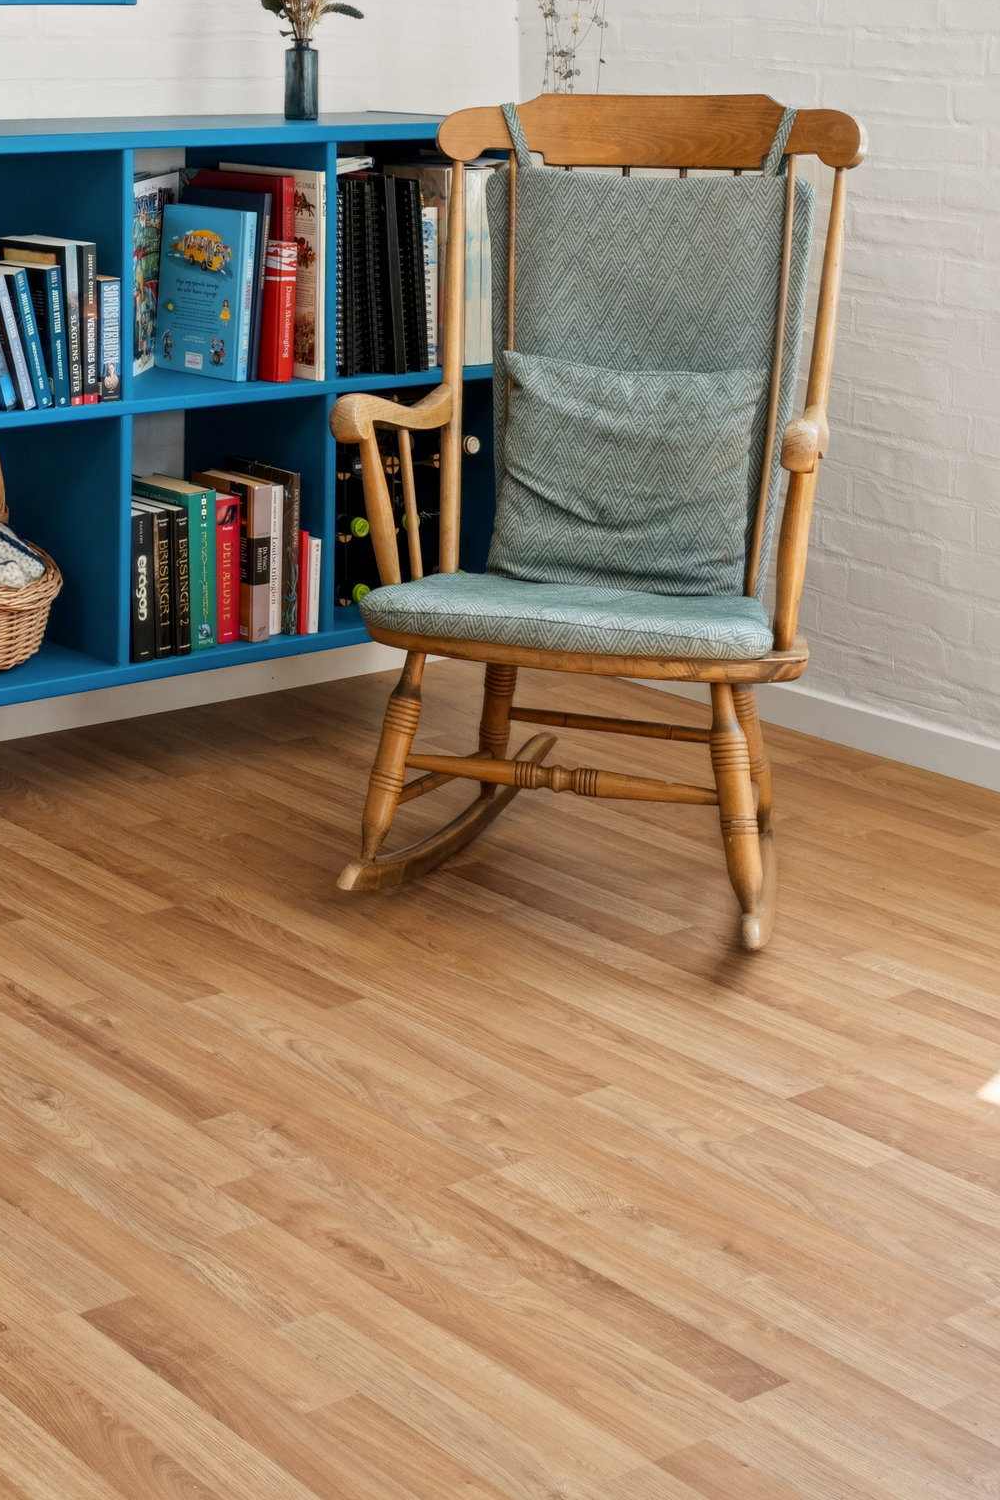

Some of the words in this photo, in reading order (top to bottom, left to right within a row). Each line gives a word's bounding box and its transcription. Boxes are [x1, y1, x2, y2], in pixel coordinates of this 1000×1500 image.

[103, 285, 119, 319] SOFIES
[244, 280, 252, 310] SANGBOG
[70, 315, 78, 361] SLÆGTENS
[87, 318, 95, 363] VENDERNES
[103, 326, 119, 364] VERDEN
[282, 309, 293, 359] Skolesangbog
[72, 364, 80, 393] OFFER
[223, 542, 232, 568] DEN
[263, 546, 268, 555] DA
[135, 554, 148, 621] eragon
[159, 540, 170, 617] BRISINGR
[176, 538, 189, 615] BRISINGR
[223, 571, 233, 620] ÆLDSTE
[179, 618, 189, 626] 2
